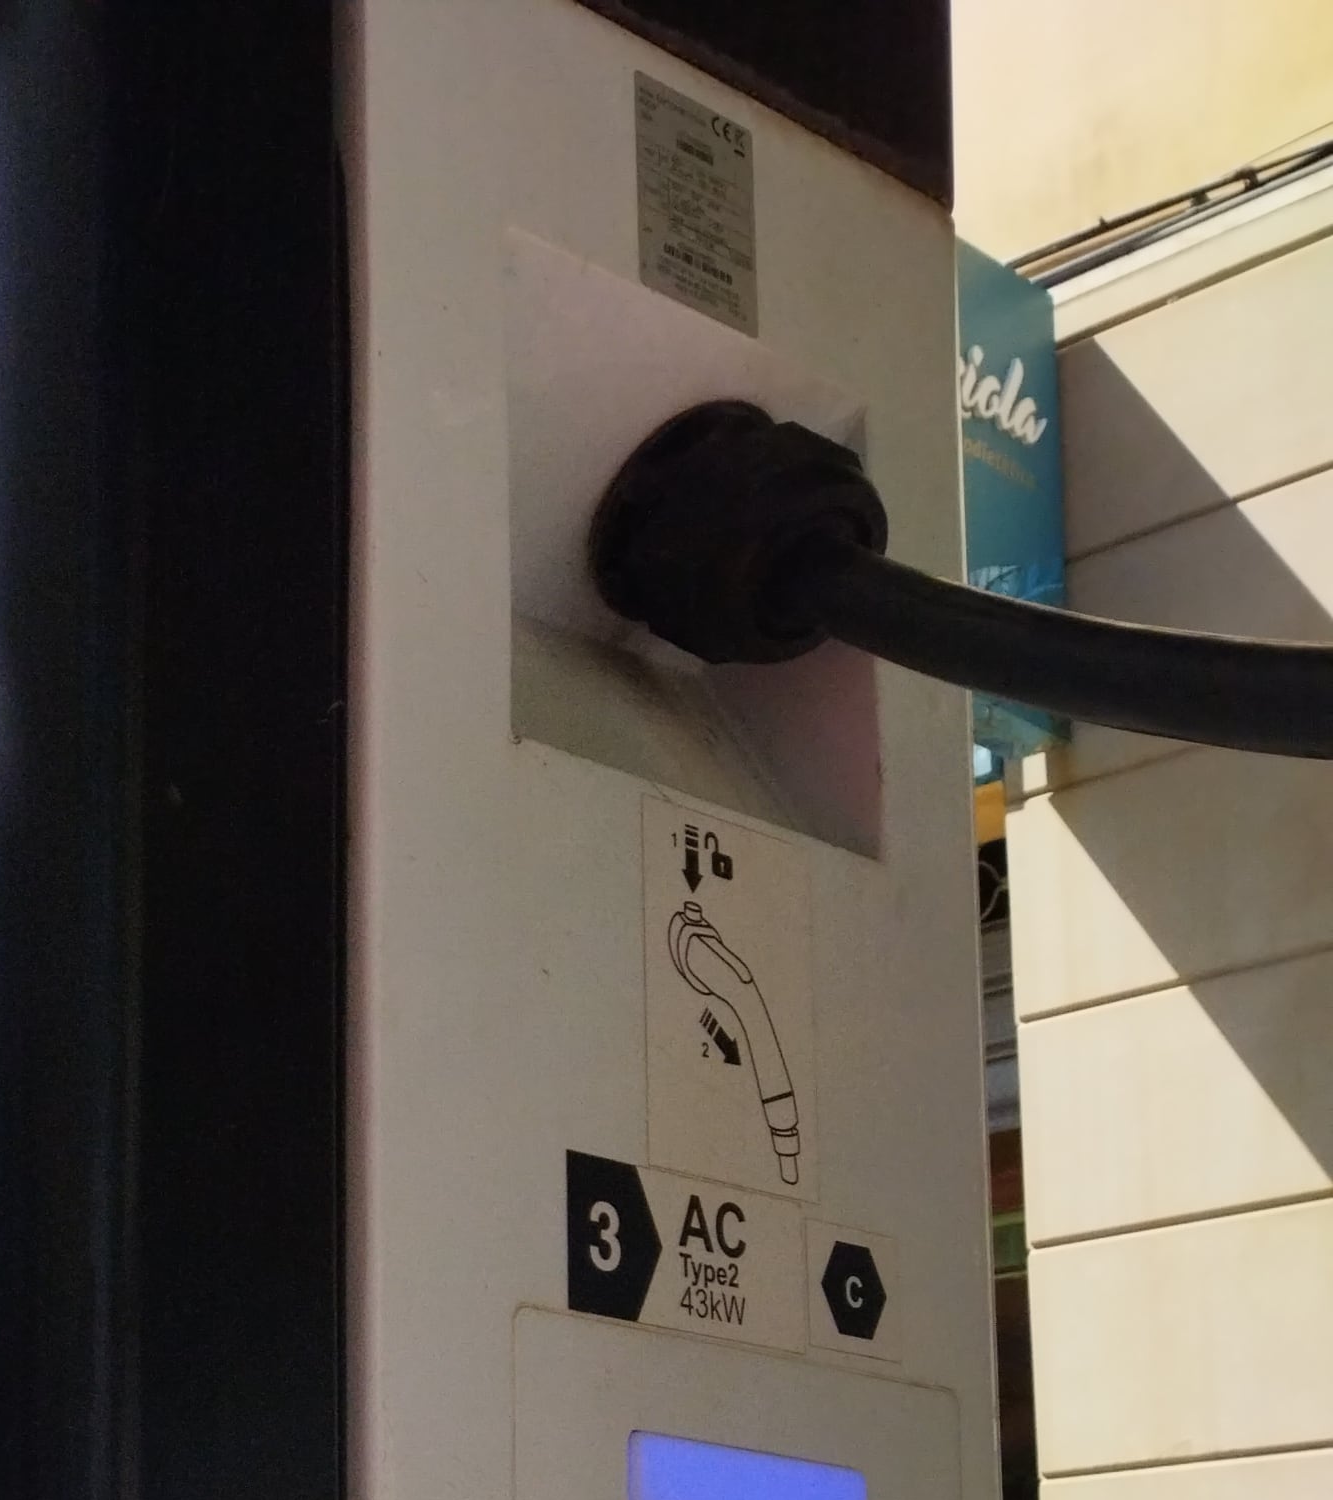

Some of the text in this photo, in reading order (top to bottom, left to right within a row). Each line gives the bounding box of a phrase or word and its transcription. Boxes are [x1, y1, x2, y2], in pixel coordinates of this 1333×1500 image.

[957, 344, 1048, 444] iola
[671, 832, 678, 848] 1
[701, 1041, 710, 1058] 2
[679, 1194, 747, 1259] AC
[589, 1201, 863, 1309] 3 Type2 C
[680, 1286, 746, 1325] 43kW
